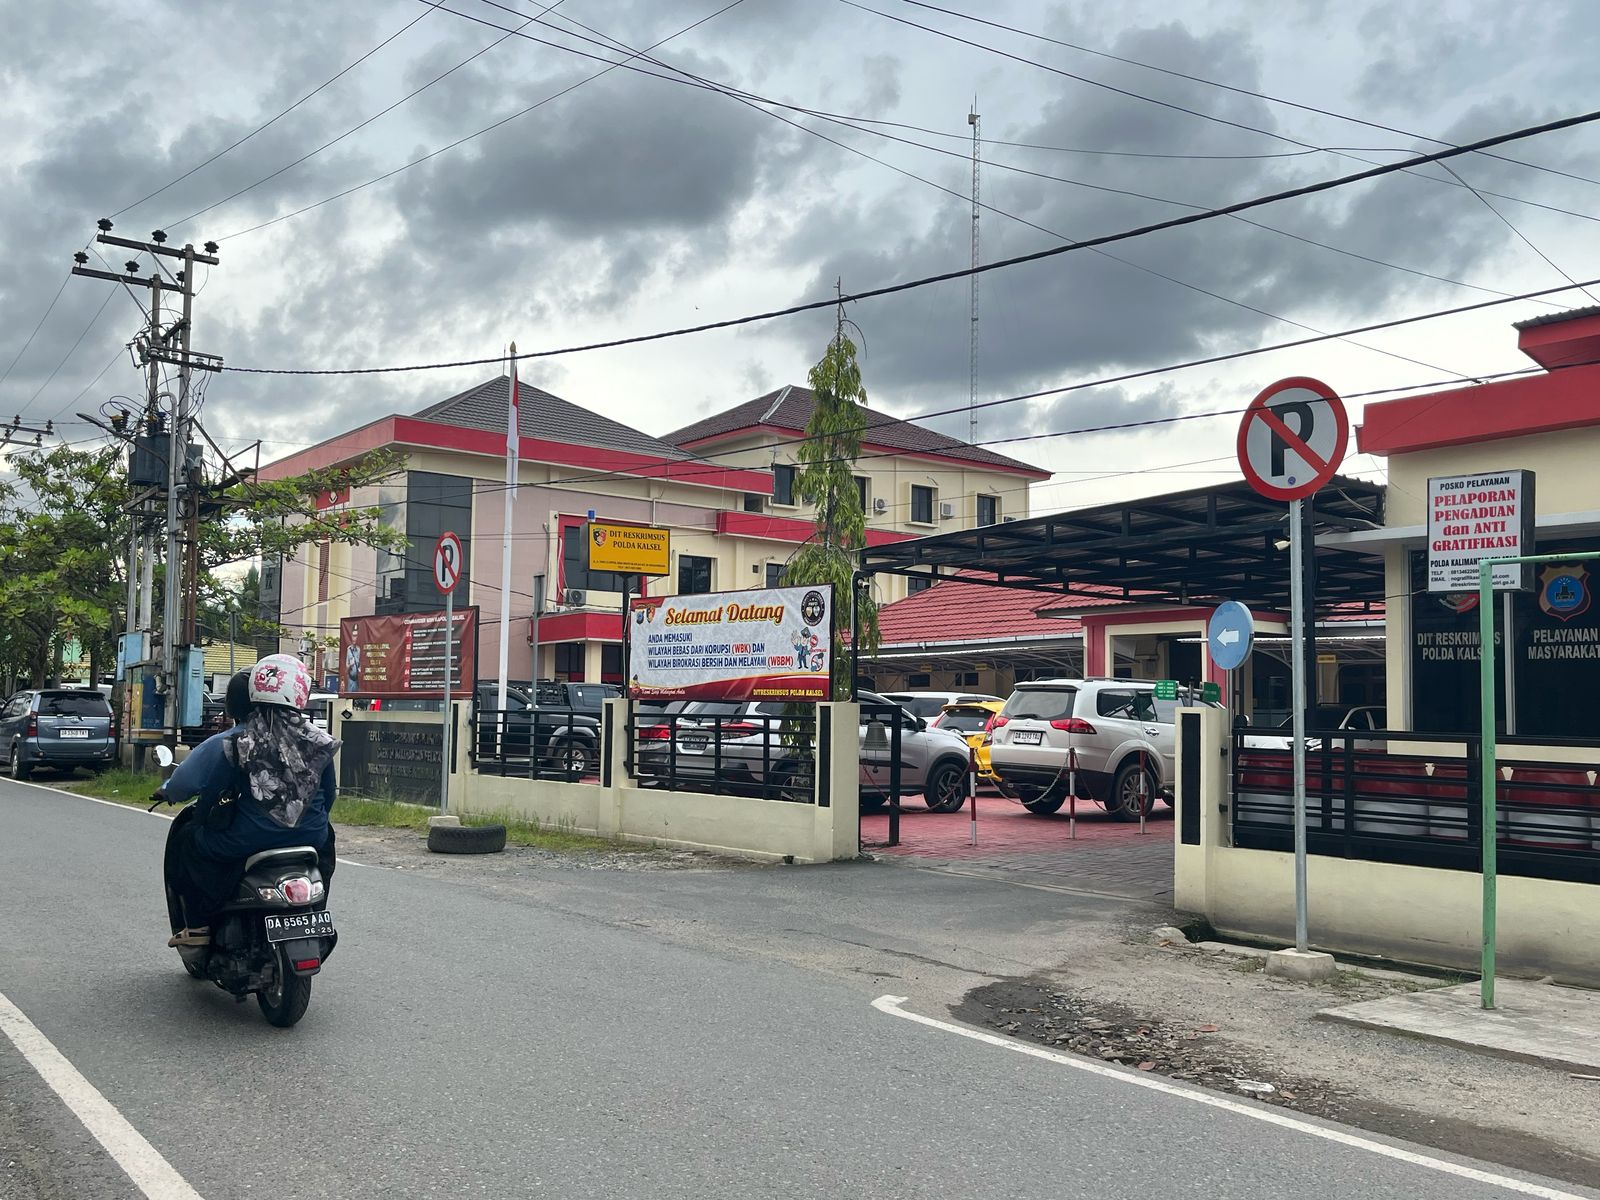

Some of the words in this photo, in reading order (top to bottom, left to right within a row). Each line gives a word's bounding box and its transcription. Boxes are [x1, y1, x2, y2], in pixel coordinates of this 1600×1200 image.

[1271, 402, 1314, 477] P
[1440, 481, 1465, 491] POSKO
[1466, 476, 1510, 489] PELAYANAN
[1434, 489, 1516, 507] PELAPORAN
[1434, 504, 1516, 522] PENGADUAN
[1443, 524, 1470, 536] dan
[1473, 520, 1506, 535] ANTI
[609, 530, 622, 538] DIT
[623, 531, 666, 541] RESKRIMSUS
[613, 541, 636, 549] POLDA
[637, 542, 662, 551] KALSEL
[1432, 535, 1518, 552] GRATIFIKASI
[1430, 559, 1450, 568] POLDA
[665, 606, 723, 625] Selamat
[726, 603, 785, 625] Datang
[648, 634, 662, 643] ANDA
[664, 633, 692, 642] MEMASUKI
[1417, 633, 1433, 645] DIT
[1435, 632, 1501, 645] RESKRIMS
[1533, 628, 1598, 643] PELAYANAN
[648, 646, 672, 655] WILAYAH
[673, 645, 690, 655] BEBAS
[691, 645, 704, 655] DARI
[705, 644, 731, 654] KORUPSI
[732, 643, 751, 654] (WBK)
[752, 643, 765, 653] DAN
[1422, 647, 1454, 660] POLDA
[1528, 645, 1600, 659] MASYARAKAT
[648, 659, 672, 668] WILAYAH
[673, 658, 700, 668] BIROKRASI
[702, 658, 723, 667] BERSIH
[724, 657, 737, 667] DAN
[739, 656, 767, 666] MELAYANI
[768, 656, 794, 667] (WBBM)
[268, 919, 281, 929] DA
[284, 915, 309, 928] 6565
